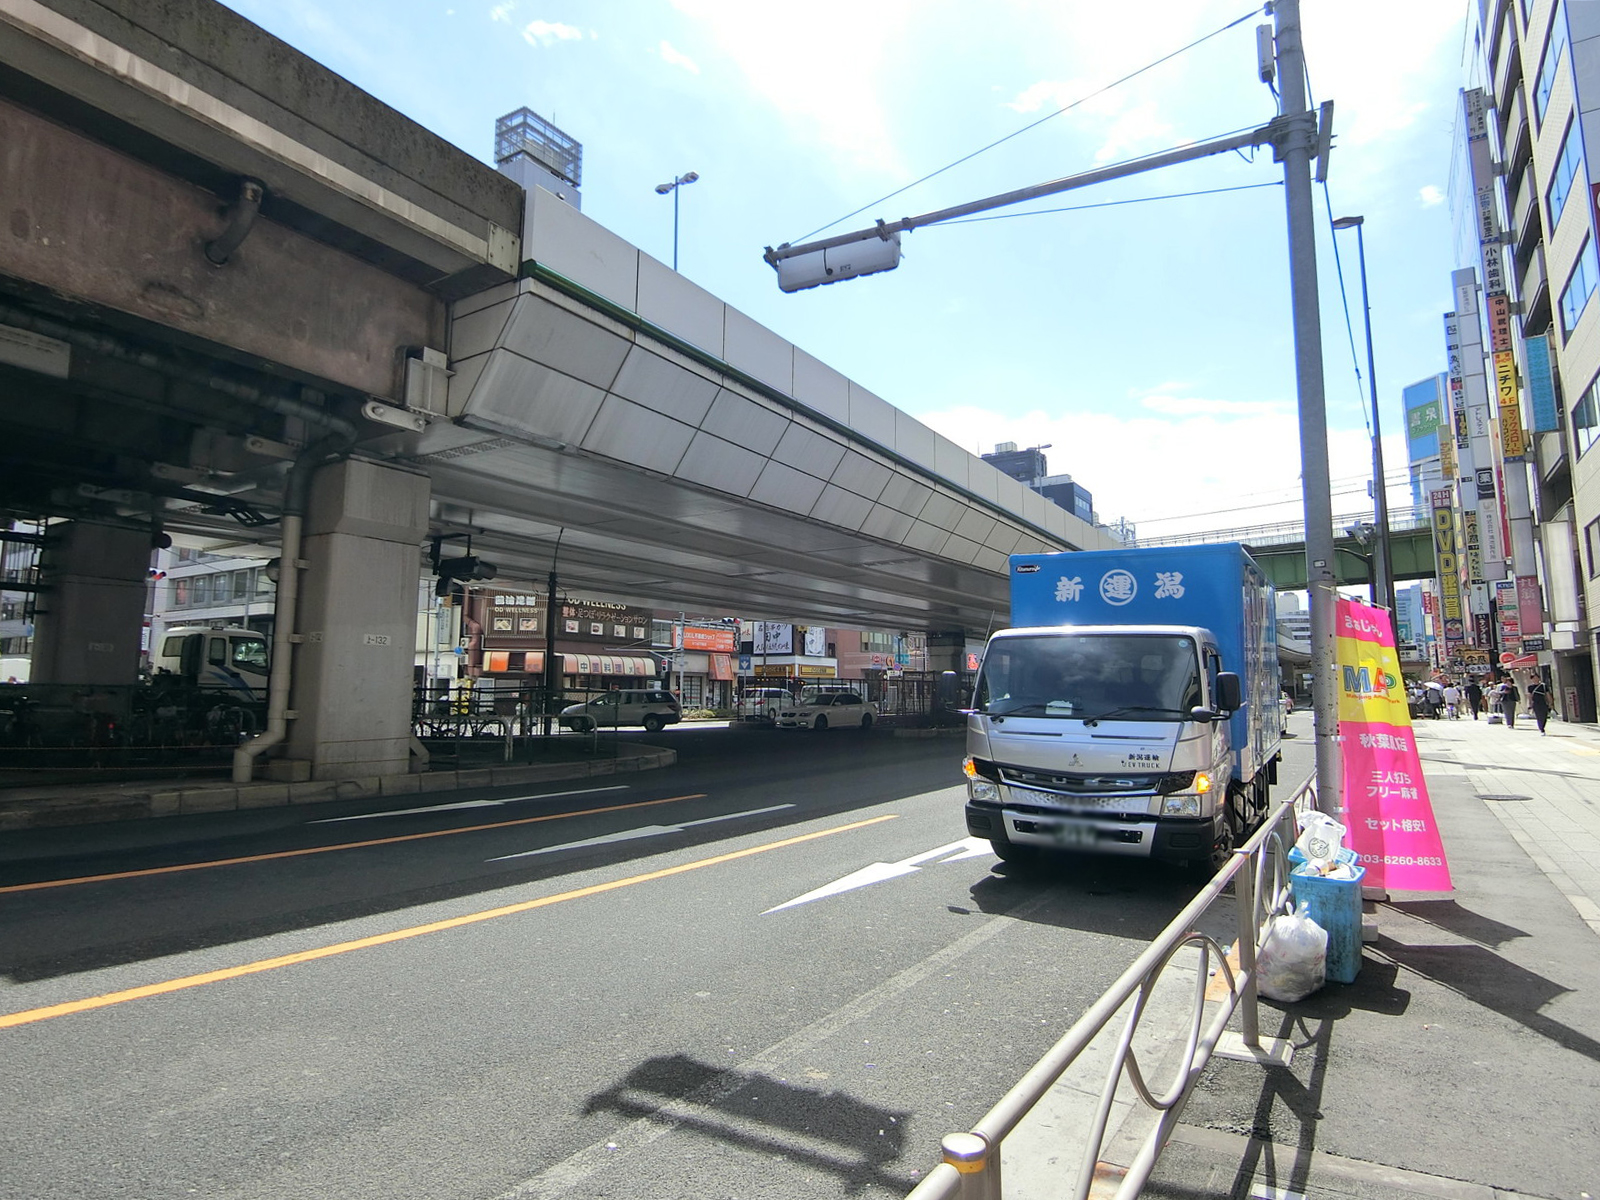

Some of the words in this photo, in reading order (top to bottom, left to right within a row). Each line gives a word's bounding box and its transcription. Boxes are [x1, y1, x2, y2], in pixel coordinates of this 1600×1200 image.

[1485, 247, 1501, 289] 小林歯科
[1498, 364, 1512, 396] ニチワ
[1500, 396, 1516, 405] 4F
[1432, 490, 1450, 500] 24H
[1054, 576, 1084, 602] 新
[1103, 575, 1132, 599] 運
[1153, 571, 1186, 600] 潟
[580, 661, 622, 673] 中国料理
[1371, 770, 1412, 784] 三人打ち
[1366, 785, 1419, 800] フリー麻雀
[1364, 817, 1426, 832] セット格安!
